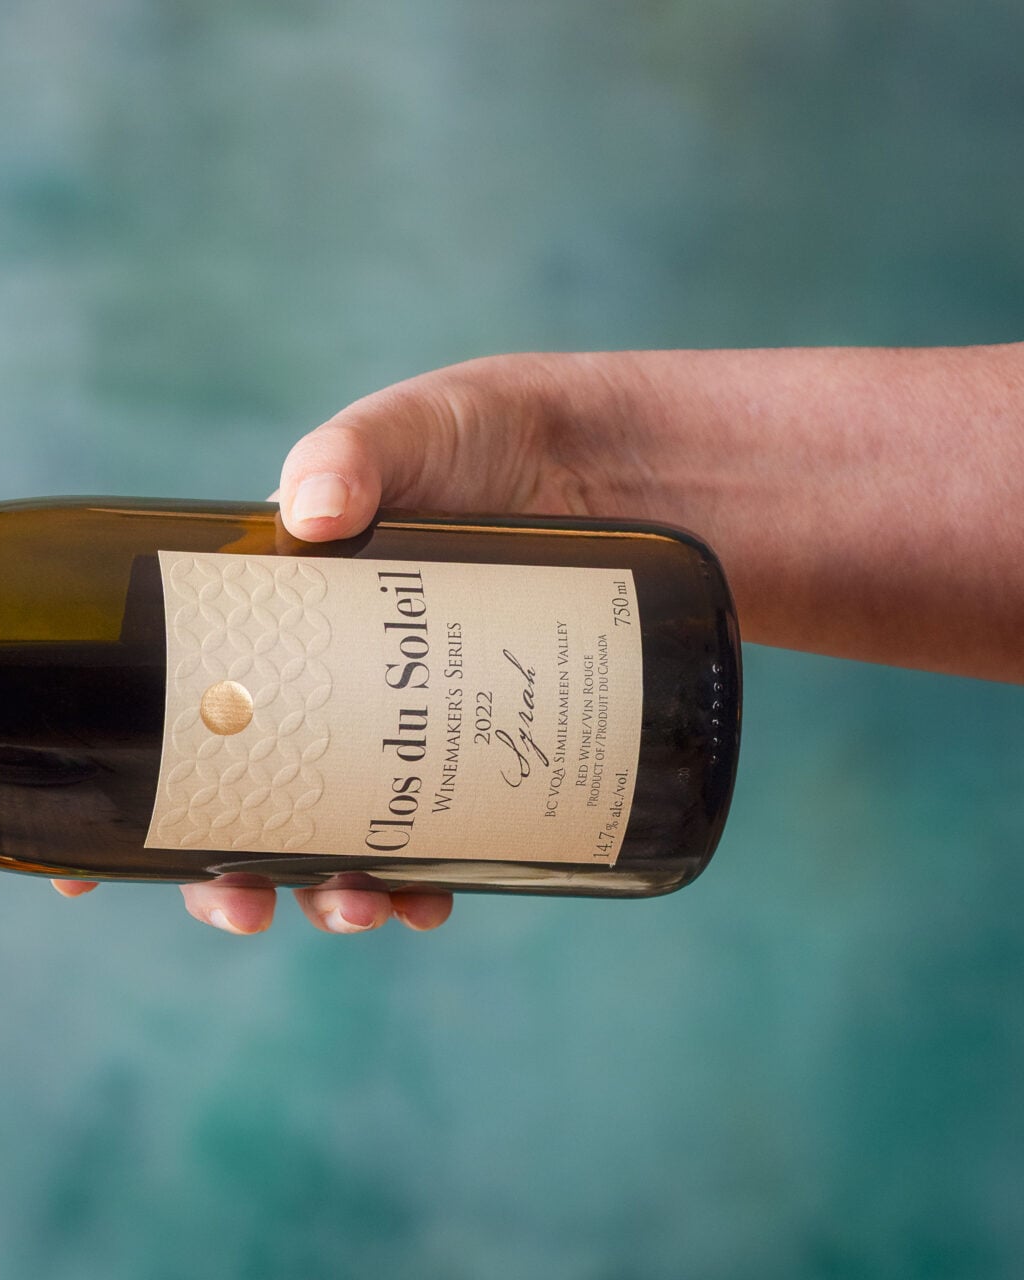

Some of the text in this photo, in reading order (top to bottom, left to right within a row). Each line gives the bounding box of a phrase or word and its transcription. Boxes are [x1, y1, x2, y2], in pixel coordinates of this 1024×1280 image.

[611, 580, 631, 627] 750 ml
[445, 621, 464, 680] SERIES
[597, 633, 608, 674] CANADA
[364, 567, 430, 851] Clos du Soleil
[598, 675, 609, 692] DU
[474, 690, 493, 745] 2022
[496, 648, 550, 789] Syrah
[544, 620, 570, 818] BC VQA SIMILKAMEEN VALLEY
[575, 653, 594, 787] RED WINE/VIN ROUGE
[586, 762, 604, 807] PRODUCT
[611, 768, 630, 819] alc./vol.
